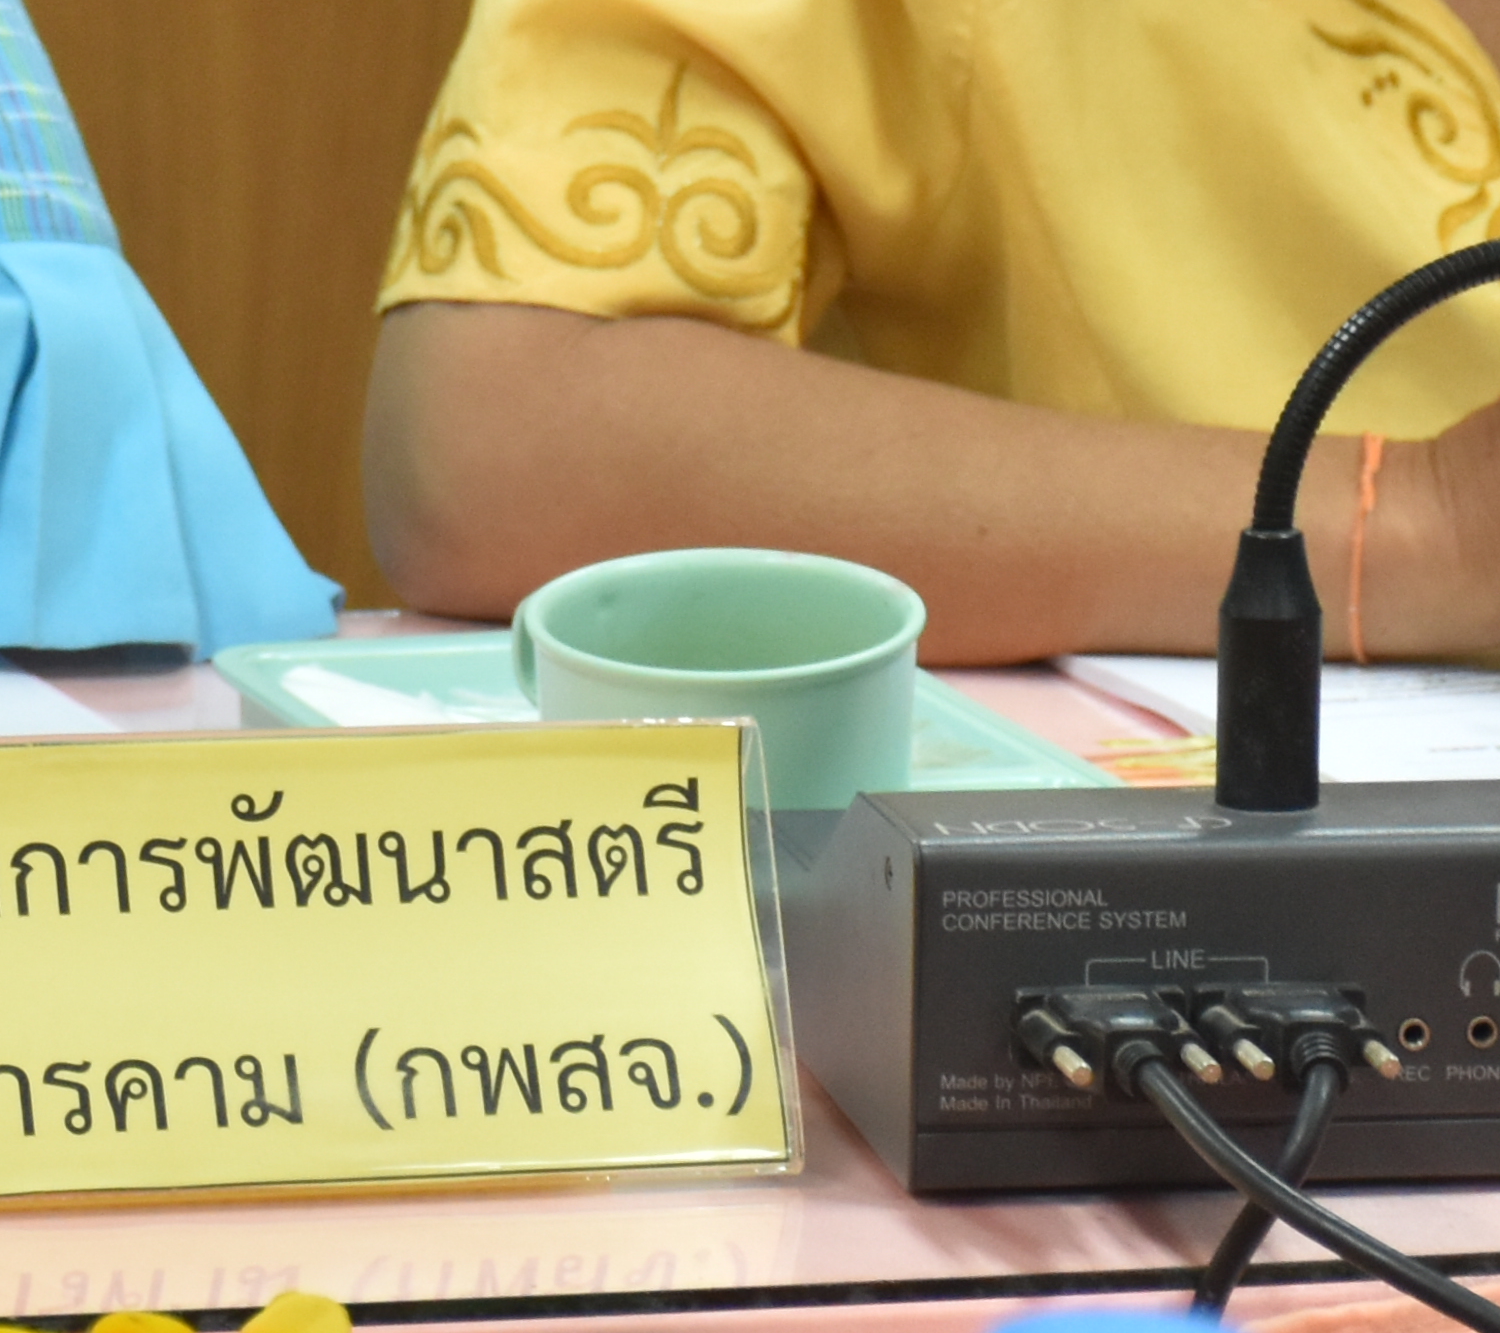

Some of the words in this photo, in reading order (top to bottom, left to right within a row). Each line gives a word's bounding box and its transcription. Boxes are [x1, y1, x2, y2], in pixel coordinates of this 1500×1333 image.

[942, 889, 1108, 910] PROFESSIONAL
[942, 912, 1091, 932] CONFERENCE
[1099, 910, 1187, 929] SYSTEM
[1150, 948, 1206, 971] LINE
[354, 1014, 754, 1131] (กพสจ.)
[940, 1074, 988, 1091] Made
[994, 1074, 1014, 1093] by
[940, 1095, 988, 1111] Made
